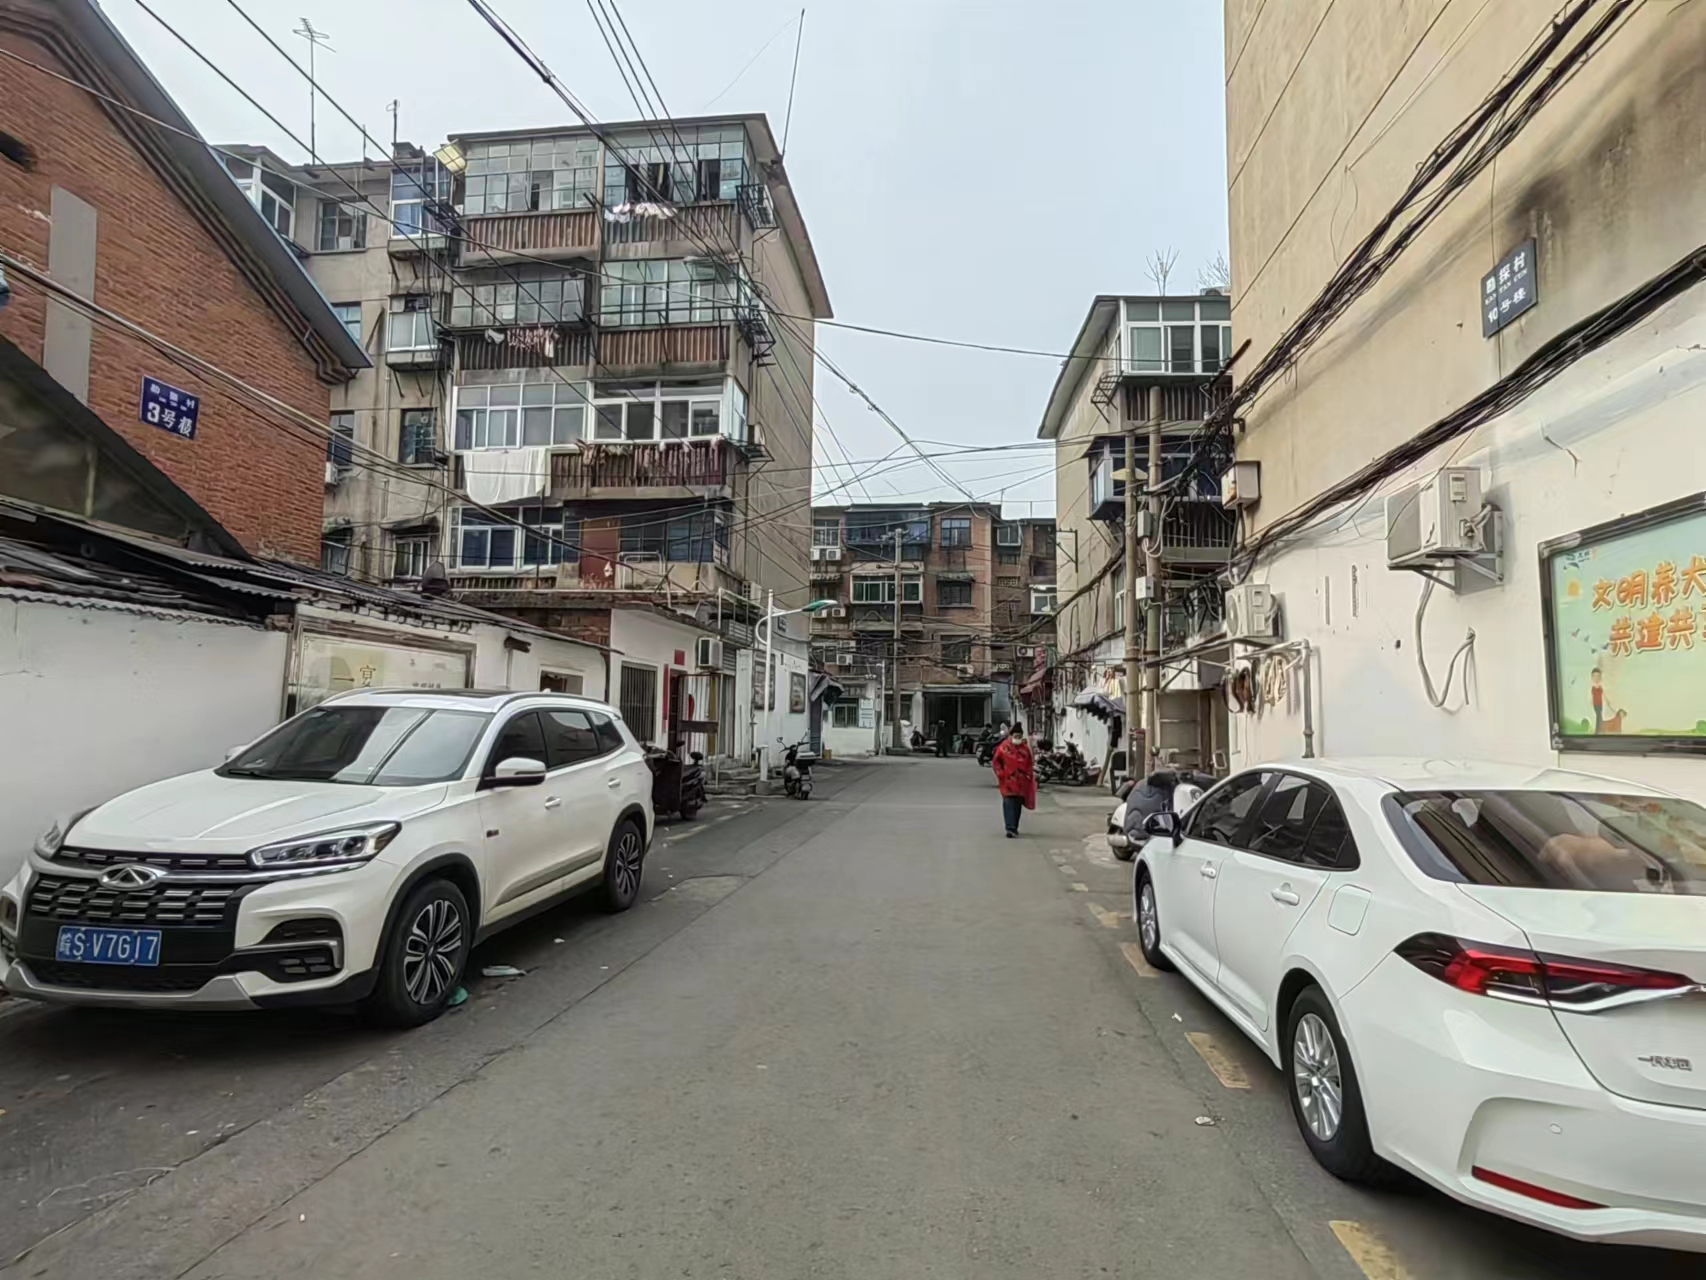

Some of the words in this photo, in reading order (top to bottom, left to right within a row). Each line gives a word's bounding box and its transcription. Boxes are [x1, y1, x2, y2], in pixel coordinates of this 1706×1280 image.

[146, 401, 193, 437] 3号楼
[1591, 553, 1706, 611] 文明养犬
[1608, 601, 1706, 656] 共建共
